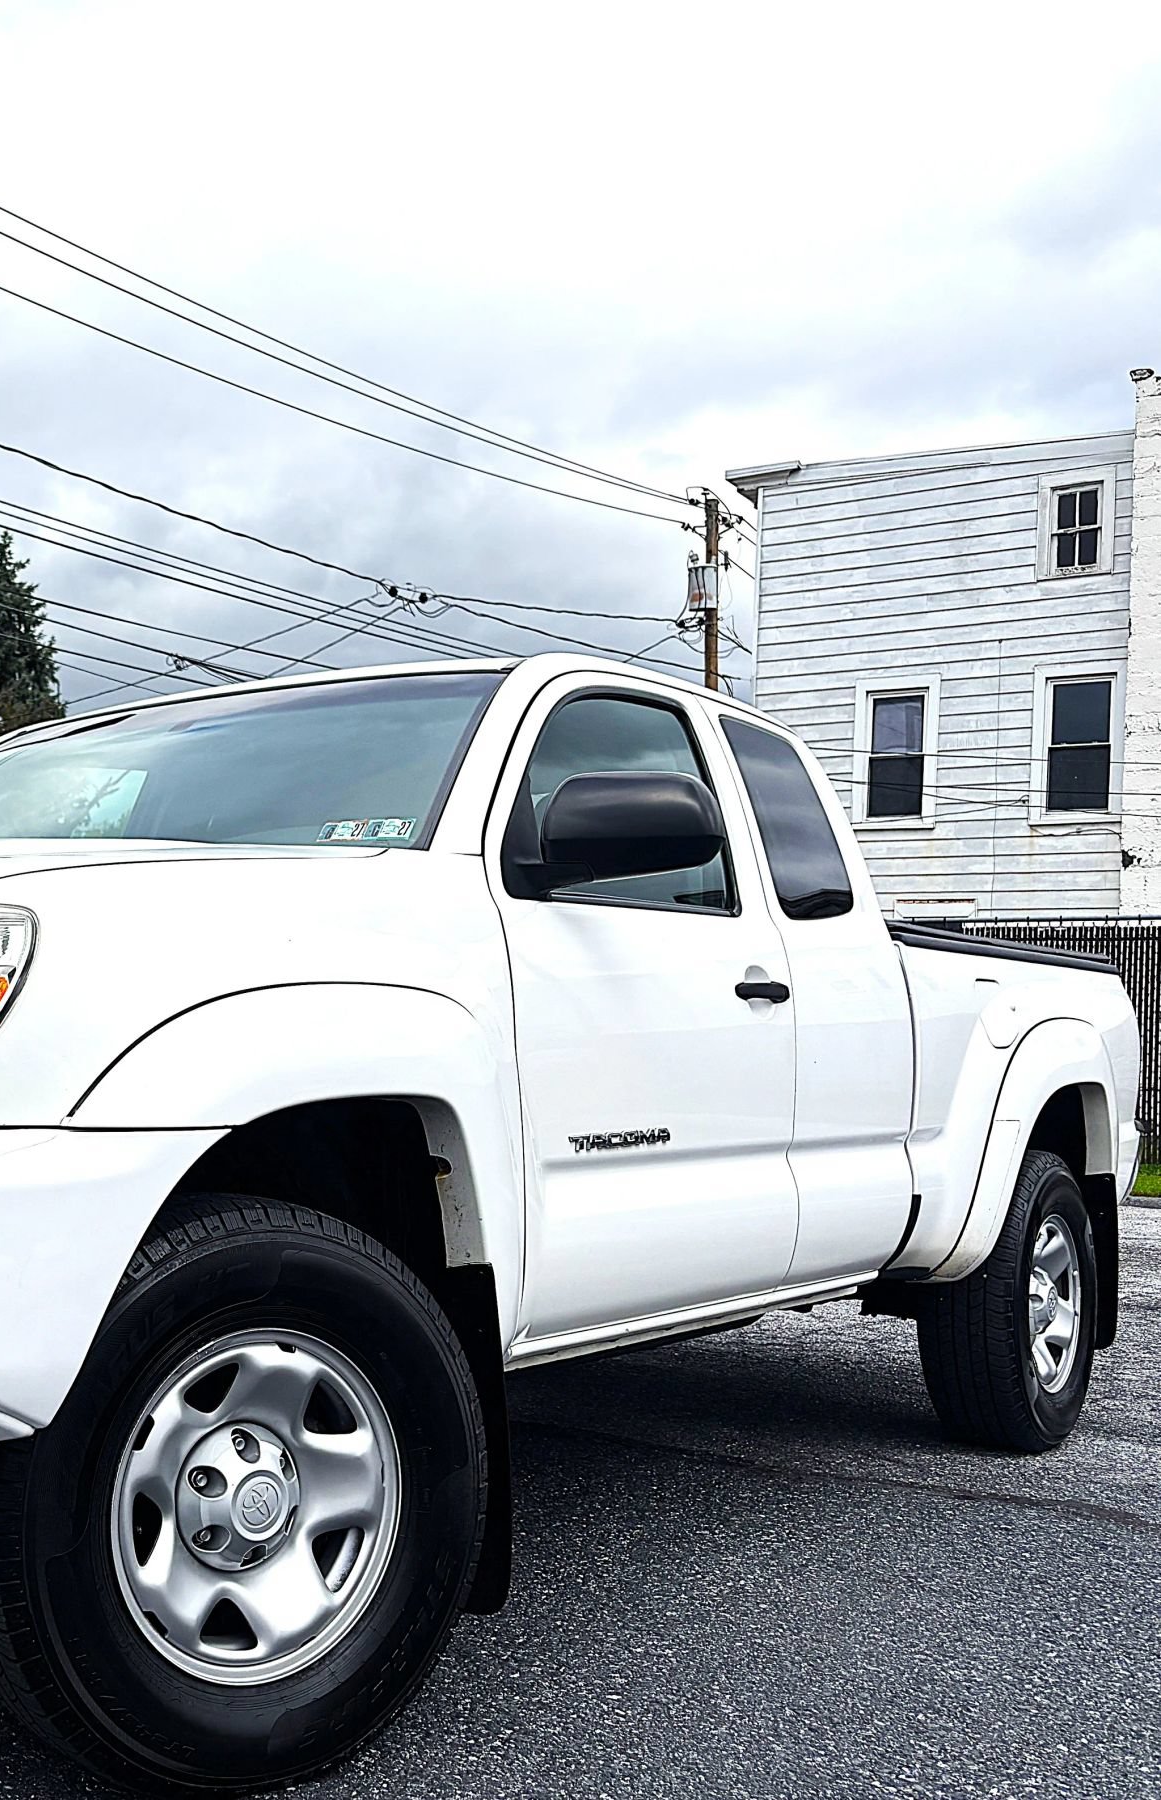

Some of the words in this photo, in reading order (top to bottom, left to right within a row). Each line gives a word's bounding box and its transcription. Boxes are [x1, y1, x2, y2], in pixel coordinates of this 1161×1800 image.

[351, 823, 365, 837] 27
[397, 821, 411, 836] 27
[568, 1128, 670, 1152] TACOMA
